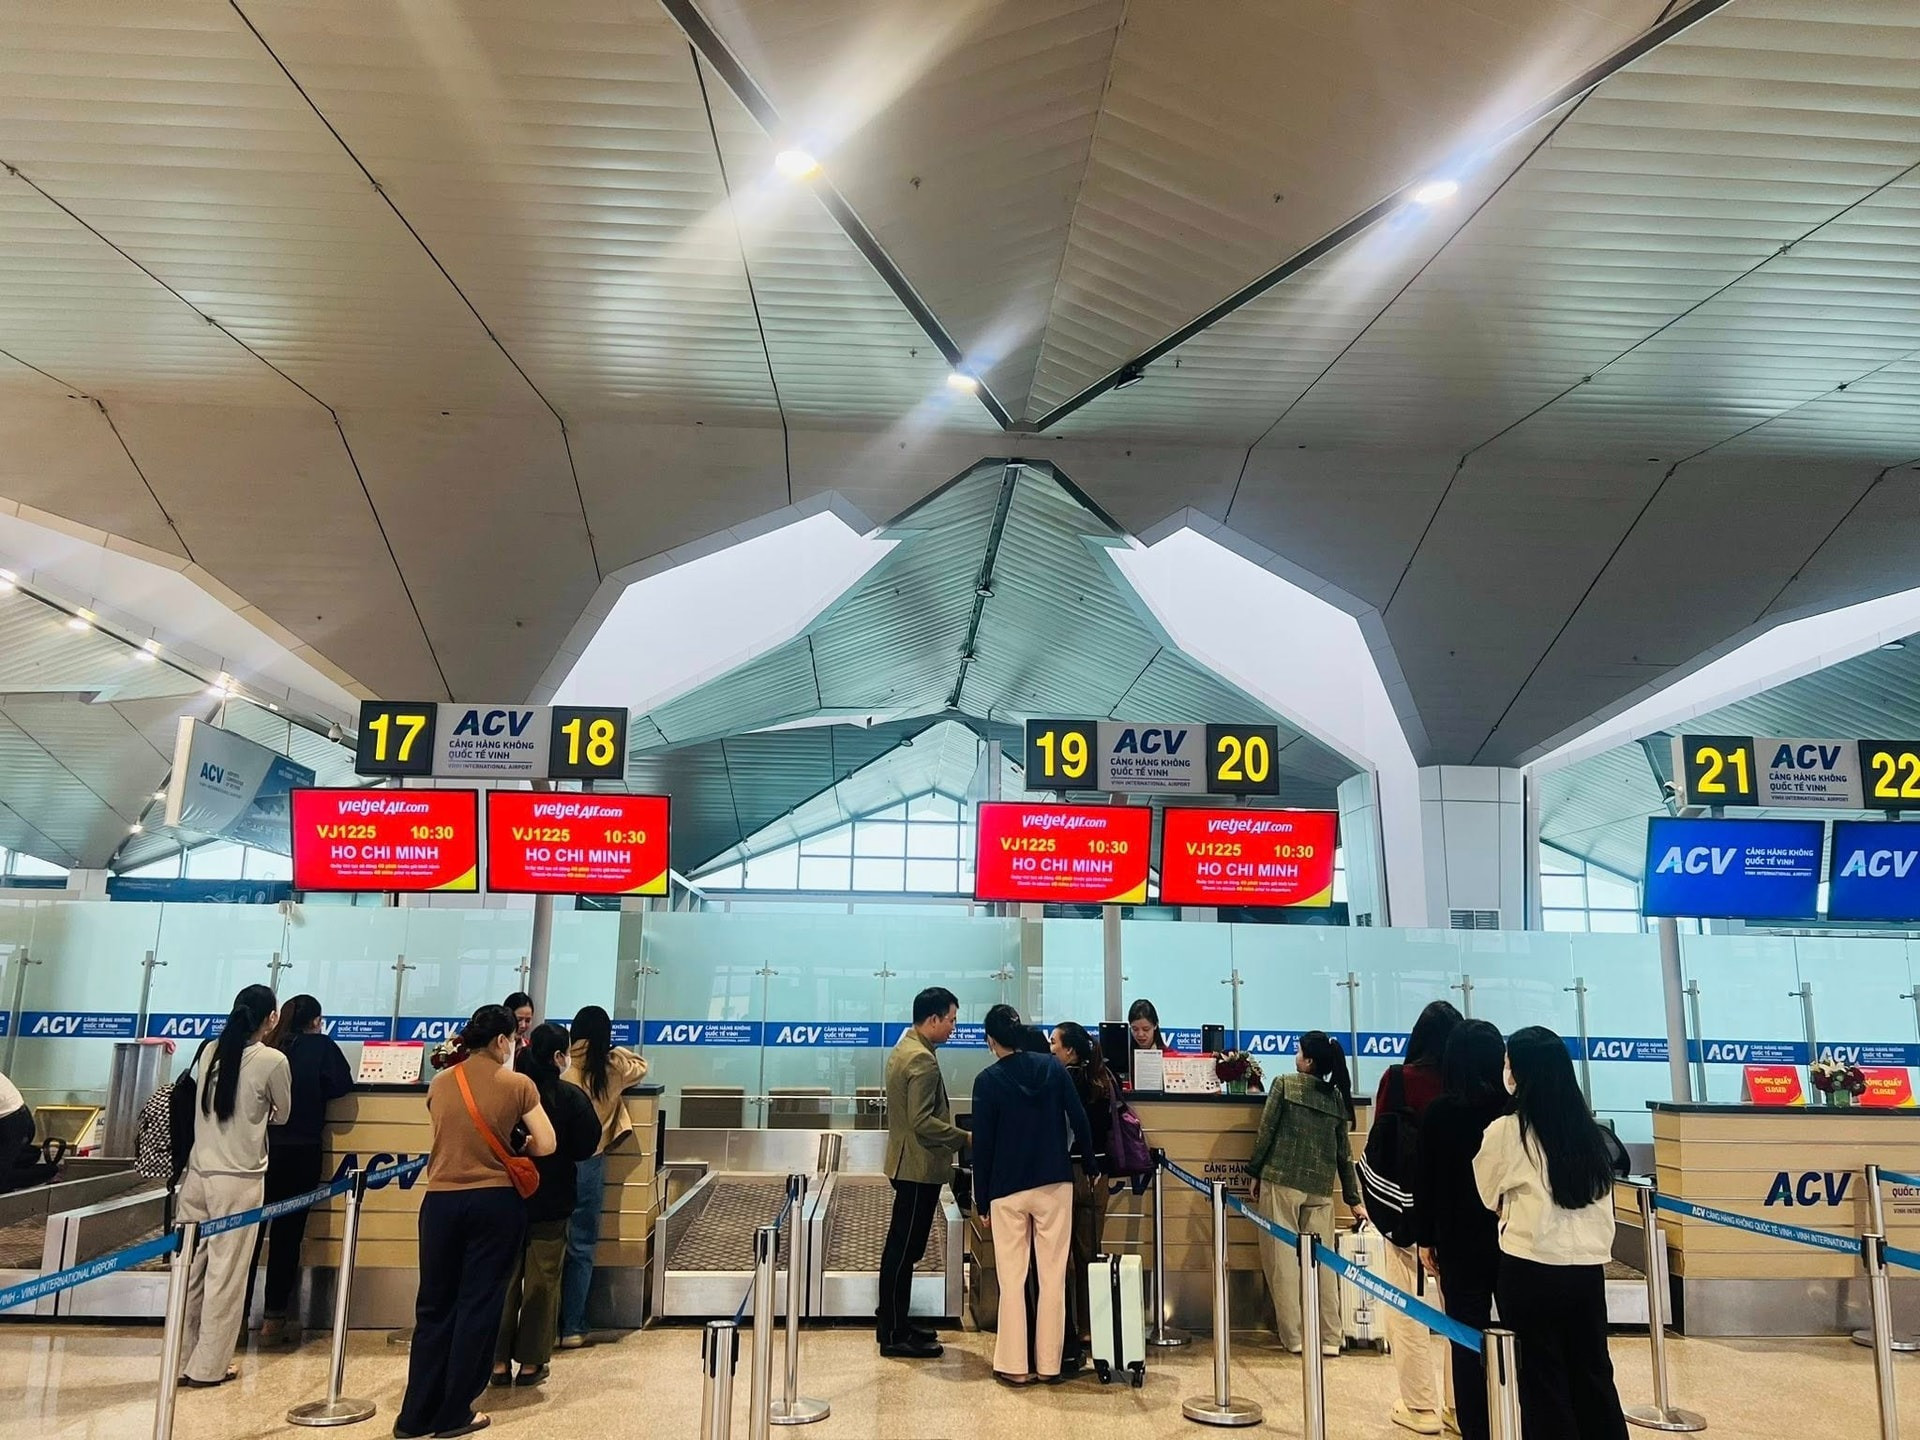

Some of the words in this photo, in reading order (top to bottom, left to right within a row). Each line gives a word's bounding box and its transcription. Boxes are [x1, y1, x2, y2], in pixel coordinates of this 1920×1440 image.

[453, 710, 534, 736] ACV
[368, 713, 426, 762] 17
[450, 739, 473, 748] CẢNG
[476, 739, 500, 748] HÀNG
[503, 741, 534, 749] KHÔNG
[561, 719, 615, 766] 18
[1113, 729, 1187, 754] ACV
[449, 749, 472, 760] QUỐC
[475, 749, 486, 758] TẾ
[1036, 731, 1088, 778] 19
[1111, 757, 1133, 766] CẢNG
[1136, 757, 1159, 766] HÀNG
[1161, 758, 1190, 767] KHÔNG
[1217, 735, 1269, 782] 20
[1771, 744, 1841, 770] ACV
[201, 762, 224, 784] ACV
[1111, 767, 1133, 776] QUỐC
[1136, 767, 1145, 776] TẾ
[1696, 747, 1749, 793] 21
[1769, 771, 1791, 780] CẢNG
[1793, 772, 1816, 781] HÀNG
[1819, 774, 1847, 782] KHÔNG
[1872, 752, 1920, 798] 22
[1770, 781, 1792, 790] QUỐC
[1794, 782, 1804, 791] TẾ
[317, 825, 376, 839] VJ1225
[411, 826, 454, 839] 10:30
[512, 827, 570, 842] VJ1225
[604, 830, 646, 844] 10:30
[331, 846, 357, 859] HO
[361, 846, 390, 859] CHI
[396, 846, 439, 859] MINH
[1000, 837, 1056, 852] VJ1225
[1088, 840, 1128, 854] 10:30
[1186, 842, 1241, 856] VJ1225
[1274, 845, 1314, 858] 10:30
[1789, 848, 1814, 856] KHÔNG
[525, 848, 550, 861] HO
[555, 849, 584, 862] CHI
[588, 850, 630, 863] MINH
[1655, 846, 1737, 875] ACV
[1840, 850, 1918, 877] ACV
[1012, 858, 1036, 870] HO
[1041, 858, 1068, 872] CHI
[1072, 859, 1113, 872] MINH
[1197, 862, 1222, 876] HO
[1226, 863, 1253, 876] CHI
[1258, 864, 1298, 878] MINH
[32, 1016, 82, 1033] ACV
[160, 1018, 210, 1035] ACV
[411, 1022, 459, 1039] ACV
[657, 1025, 703, 1042] ACV
[776, 1026, 822, 1043] ACV
[1248, 1035, 1290, 1052] ACV
[1363, 1036, 1407, 1053] ACV
[1592, 1041, 1634, 1058] ACV
[1707, 1044, 1748, 1061] ACV
[1819, 1046, 1860, 1062] ACV
[331, 1153, 430, 1190] ACV
[1205, 1162, 1226, 1172] CẢNG
[1229, 1162, 1247, 1172] HÀN
[1229, 1174, 1238, 1185] TẾ
[1764, 1172, 1851, 1207] ACV
[1692, 1206, 1705, 1216] ACV
[1796, 1231, 1810, 1240] VINH
[1811, 1234, 1856, 1250] INTERNATIONAL
[21, 1285, 39, 1299] VINH
[39, 1269, 90, 1293] INTERNATIONAL
[90, 1258, 118, 1276] AIRPORT
